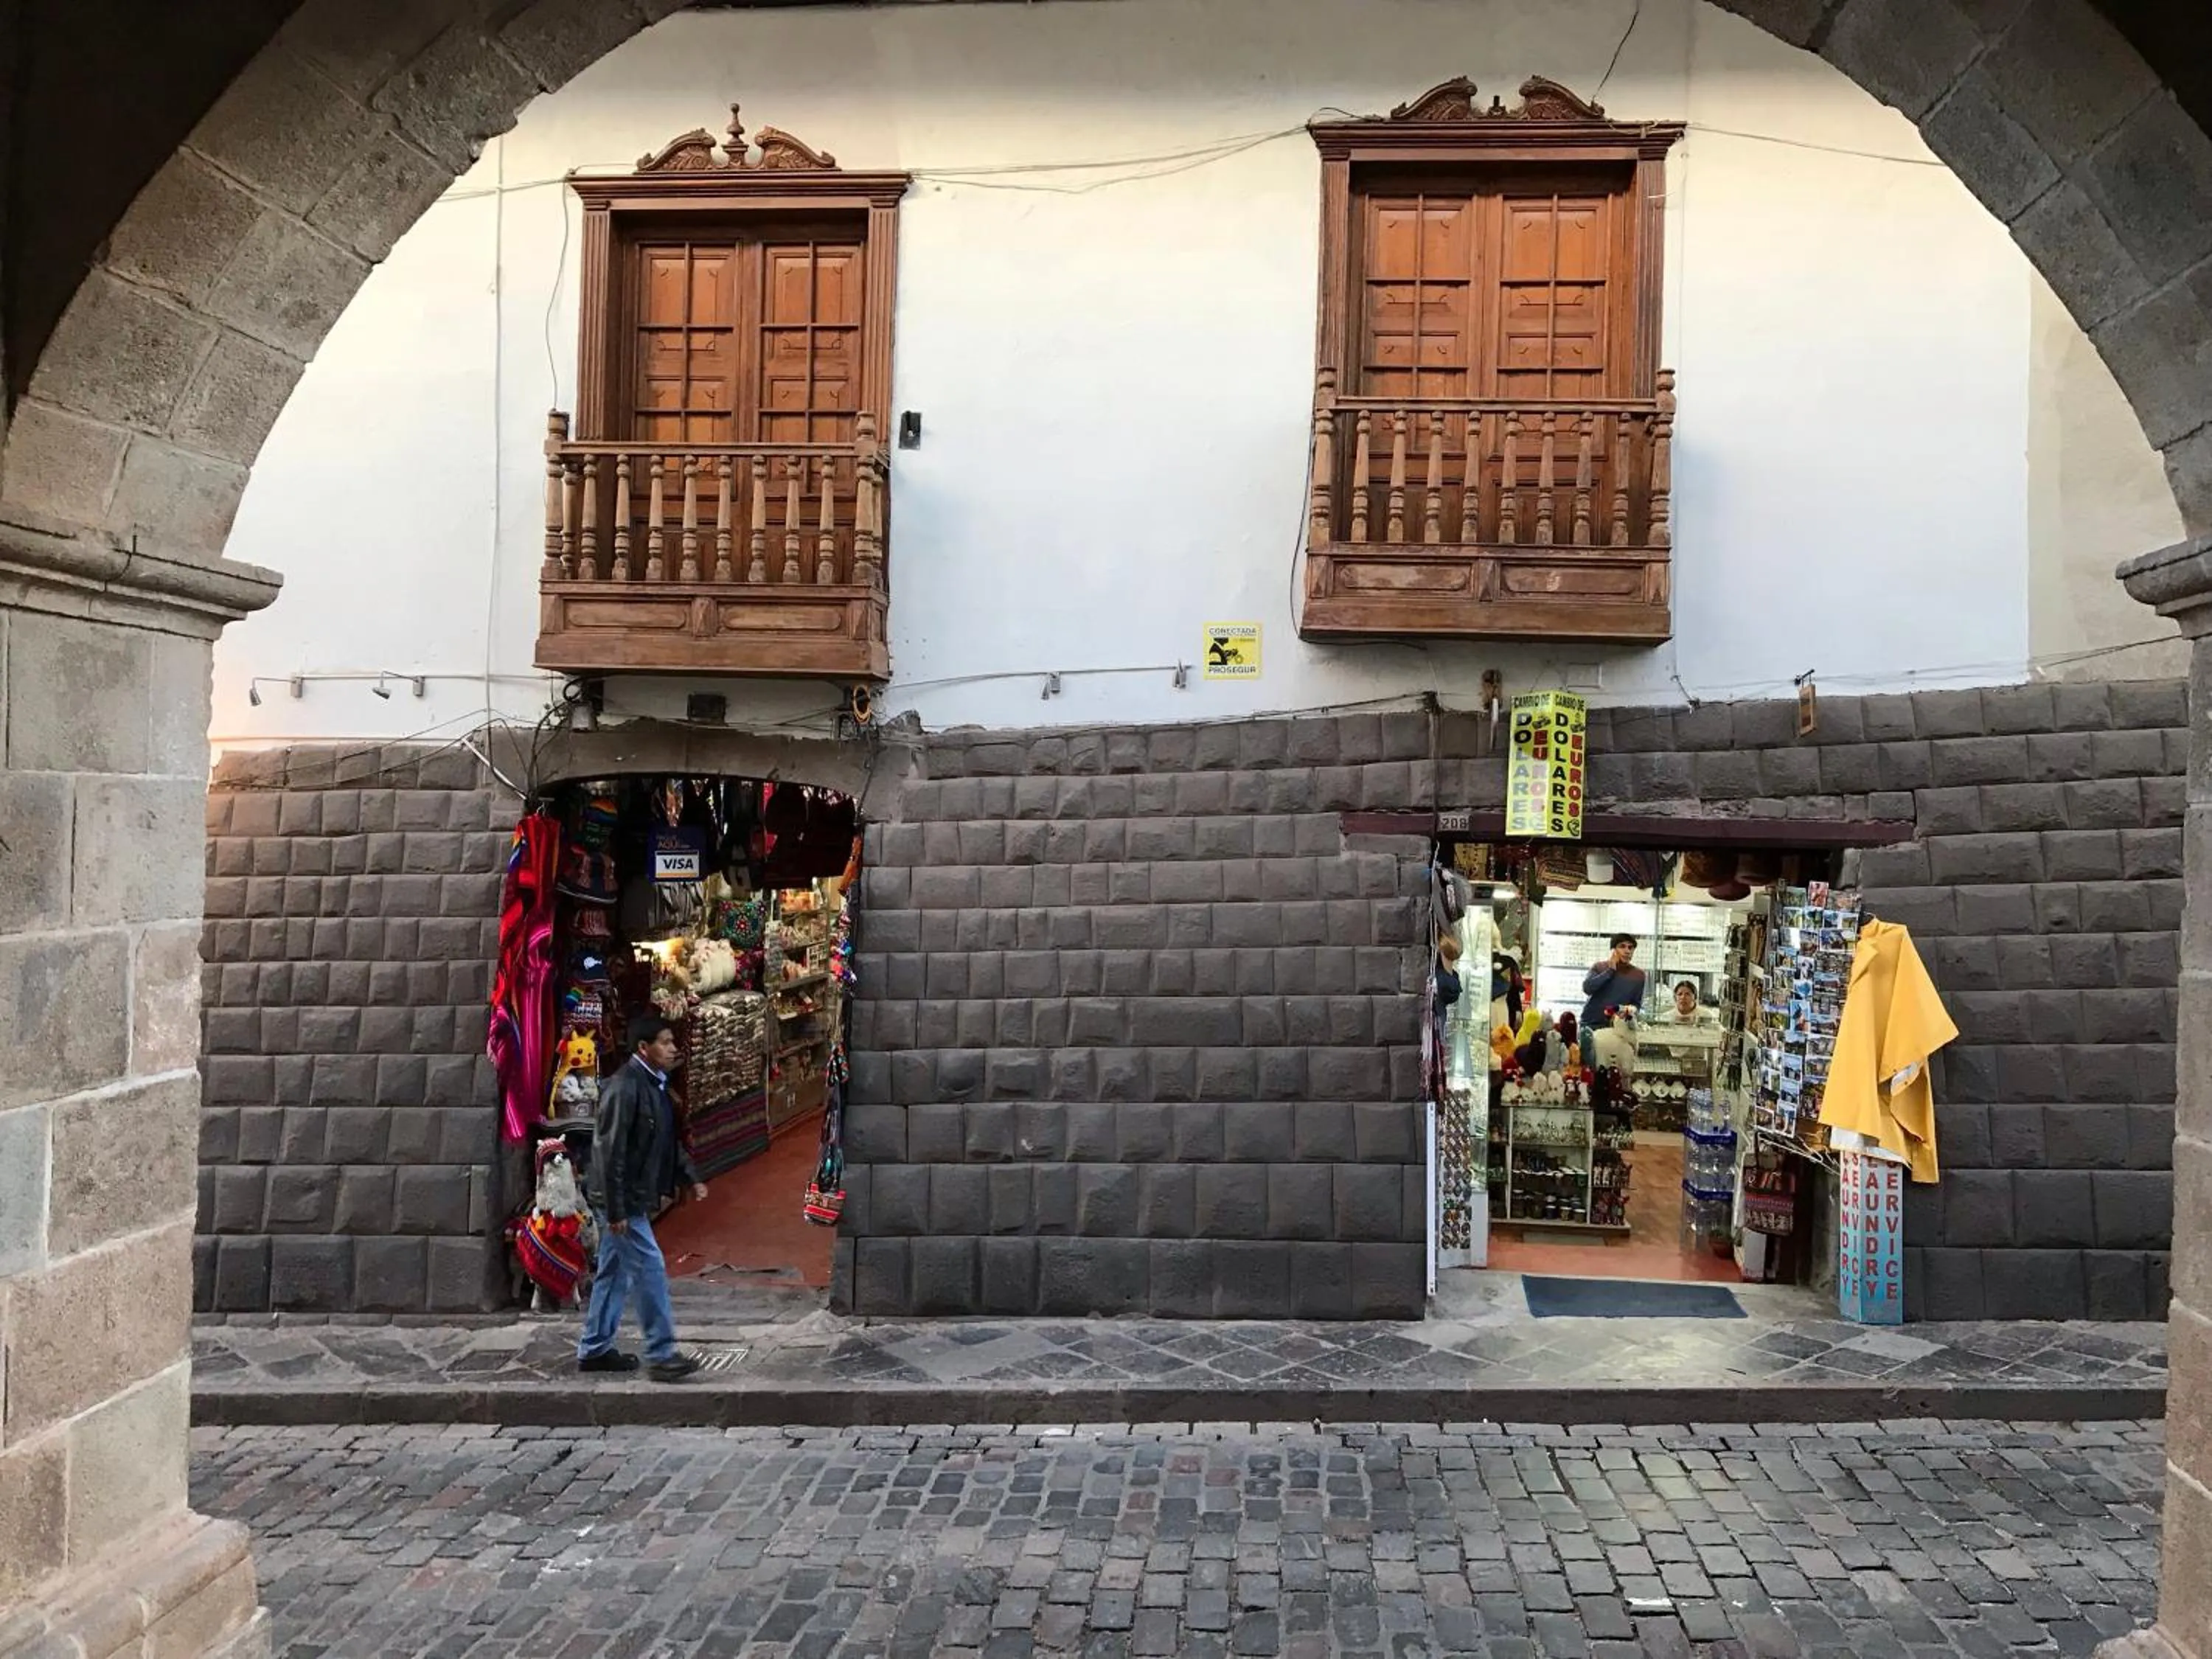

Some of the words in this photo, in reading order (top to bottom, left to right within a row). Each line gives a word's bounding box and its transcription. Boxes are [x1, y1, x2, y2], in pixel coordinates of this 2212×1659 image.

[1208, 666, 1256, 674] PROSEGUR
[1514, 695, 1539, 709] CAMBIO
[1512, 712, 1532, 830] DOLARES
[1551, 712, 1568, 832] DOLARES
[1568, 734, 1582, 818] EUROS
[663, 858, 694, 869] VISA
